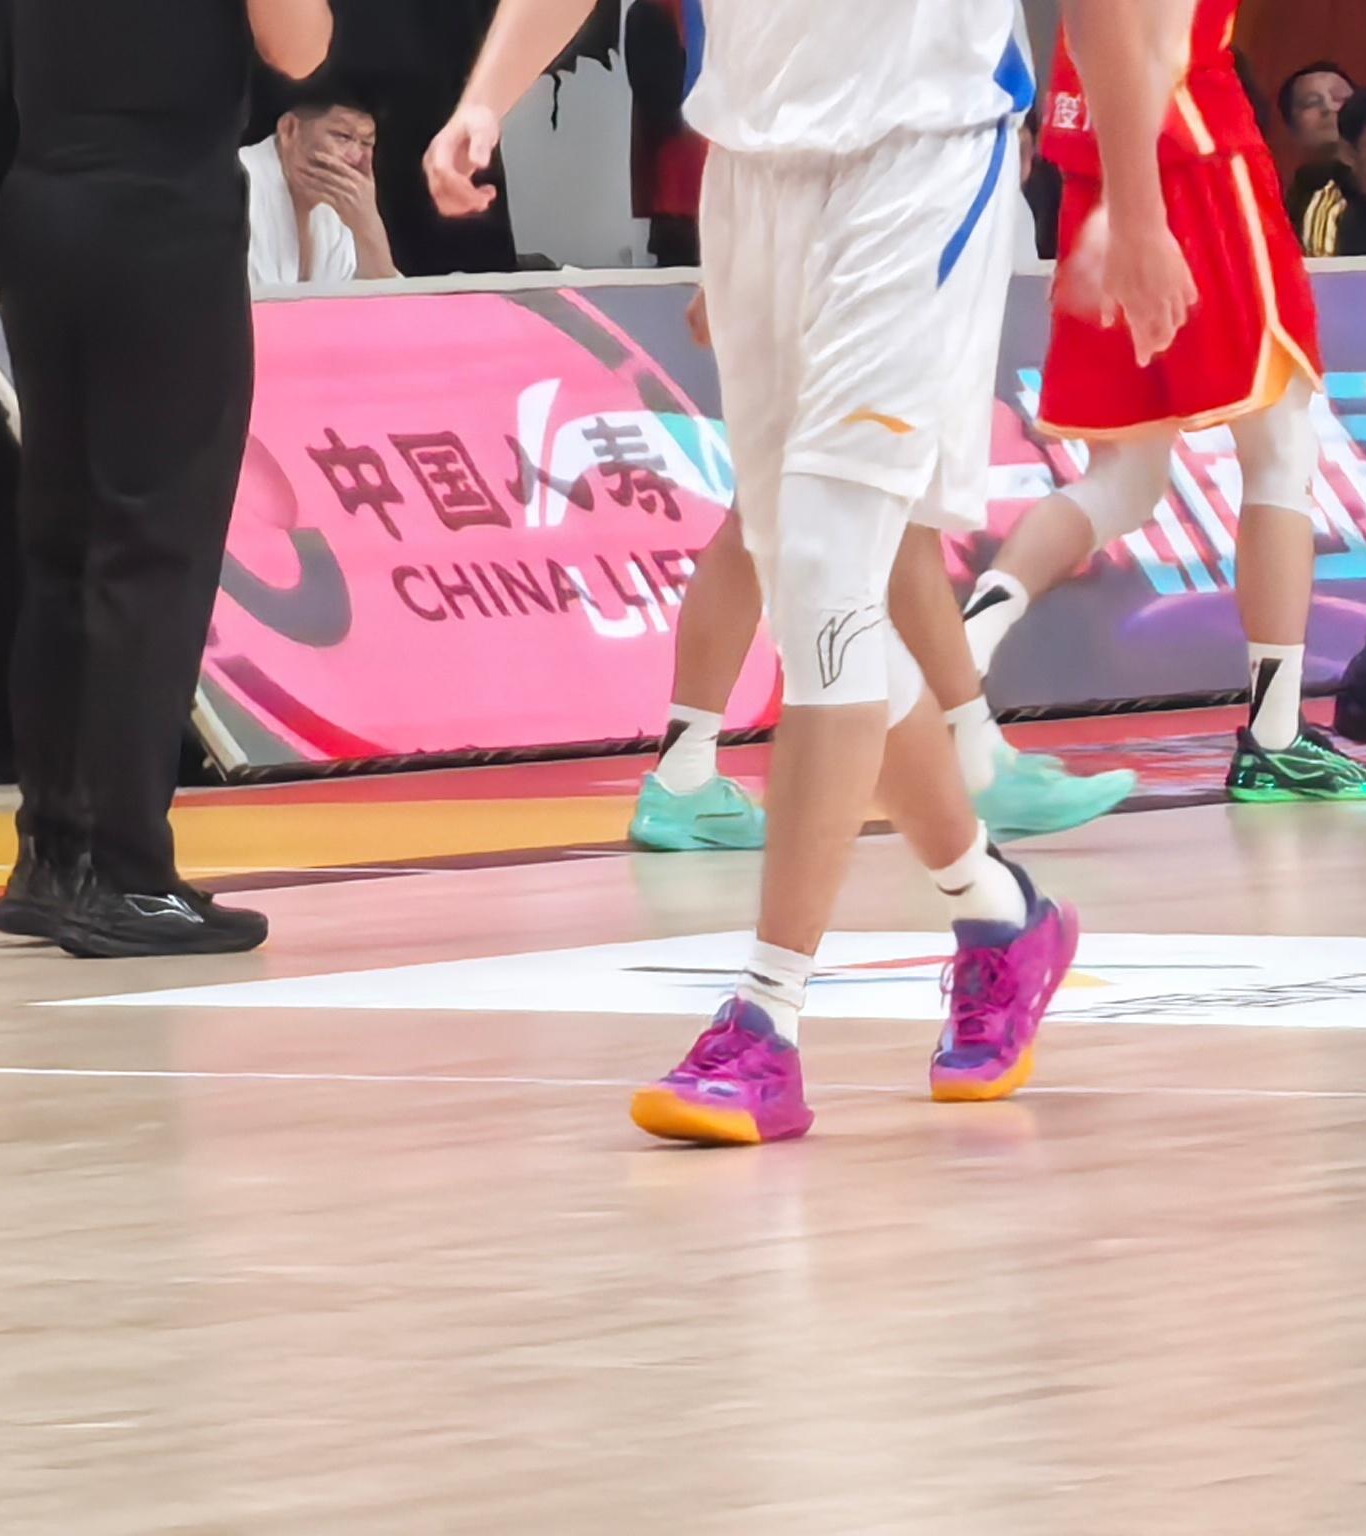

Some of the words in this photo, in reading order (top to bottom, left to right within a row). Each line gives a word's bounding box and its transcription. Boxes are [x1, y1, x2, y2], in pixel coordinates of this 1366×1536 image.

[305, 416, 683, 542] 中国人寿
[392, 560, 601, 622] CHINA
[594, 548, 703, 608] LIF
